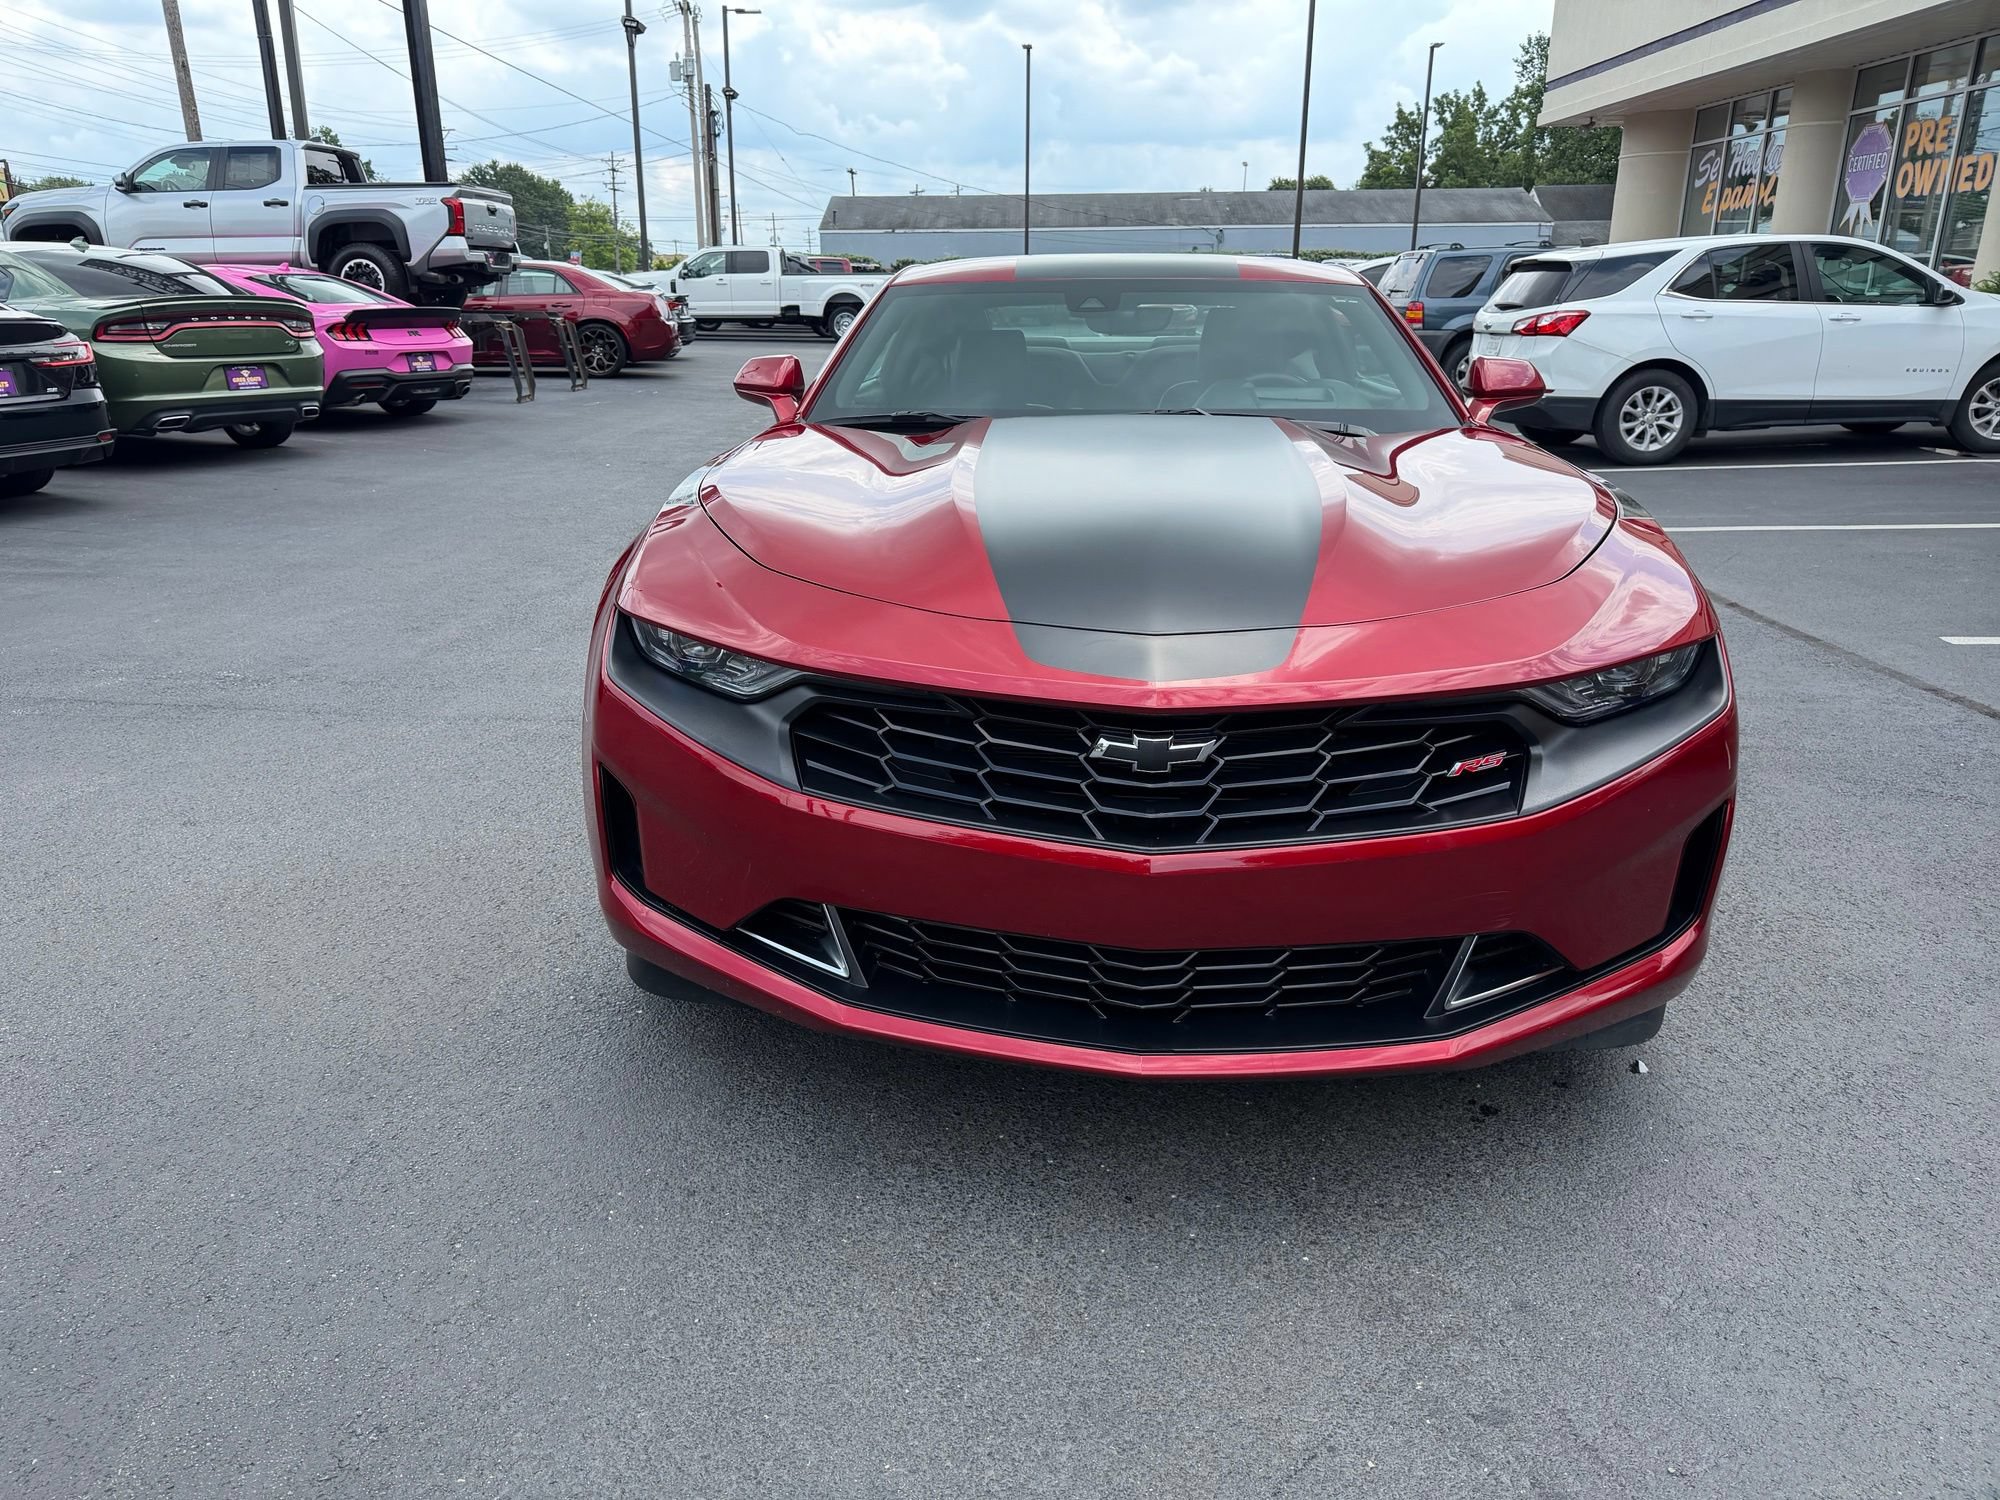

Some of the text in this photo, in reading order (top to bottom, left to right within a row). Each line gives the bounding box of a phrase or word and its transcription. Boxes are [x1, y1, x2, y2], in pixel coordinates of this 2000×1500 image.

[1694, 149, 1721, 188] Se
[1848, 152, 1888, 173] CERTIFIED
[1896, 153, 1994, 199] OWNED
[1701, 172, 1777, 223] Epañl
[1447, 752, 1507, 777] RS
